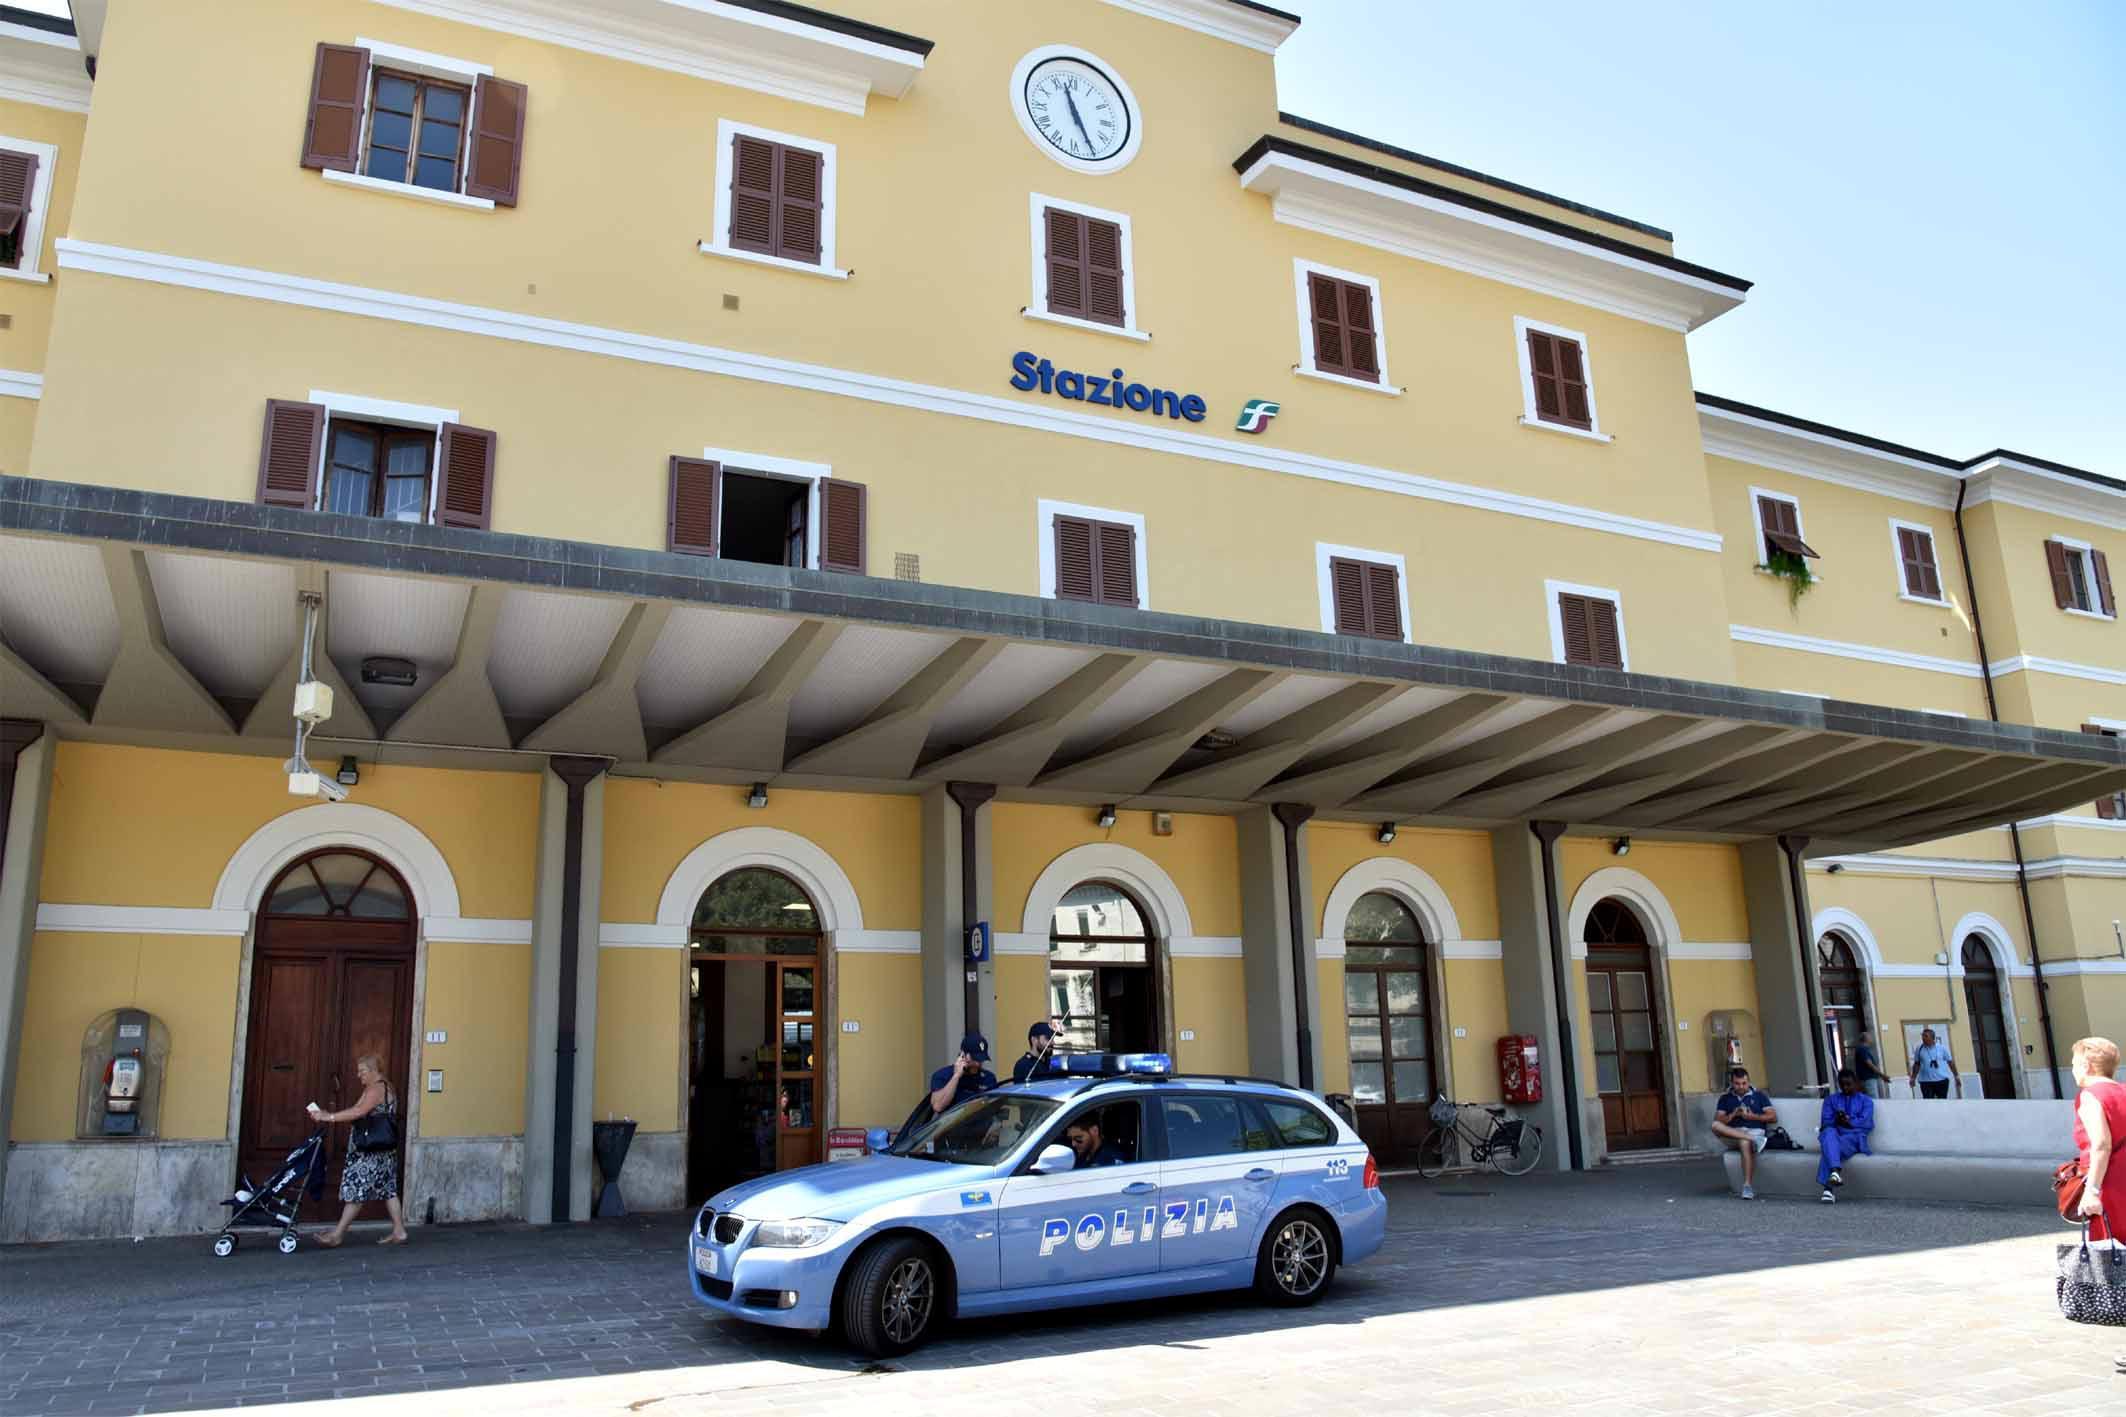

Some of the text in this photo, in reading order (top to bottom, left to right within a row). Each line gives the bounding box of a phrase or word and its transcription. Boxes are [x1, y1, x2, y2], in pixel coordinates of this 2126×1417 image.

[1010, 351, 1207, 423] Stazione
[1327, 1159, 1349, 1176] 113
[1039, 1195, 1239, 1256] POLIZIA
